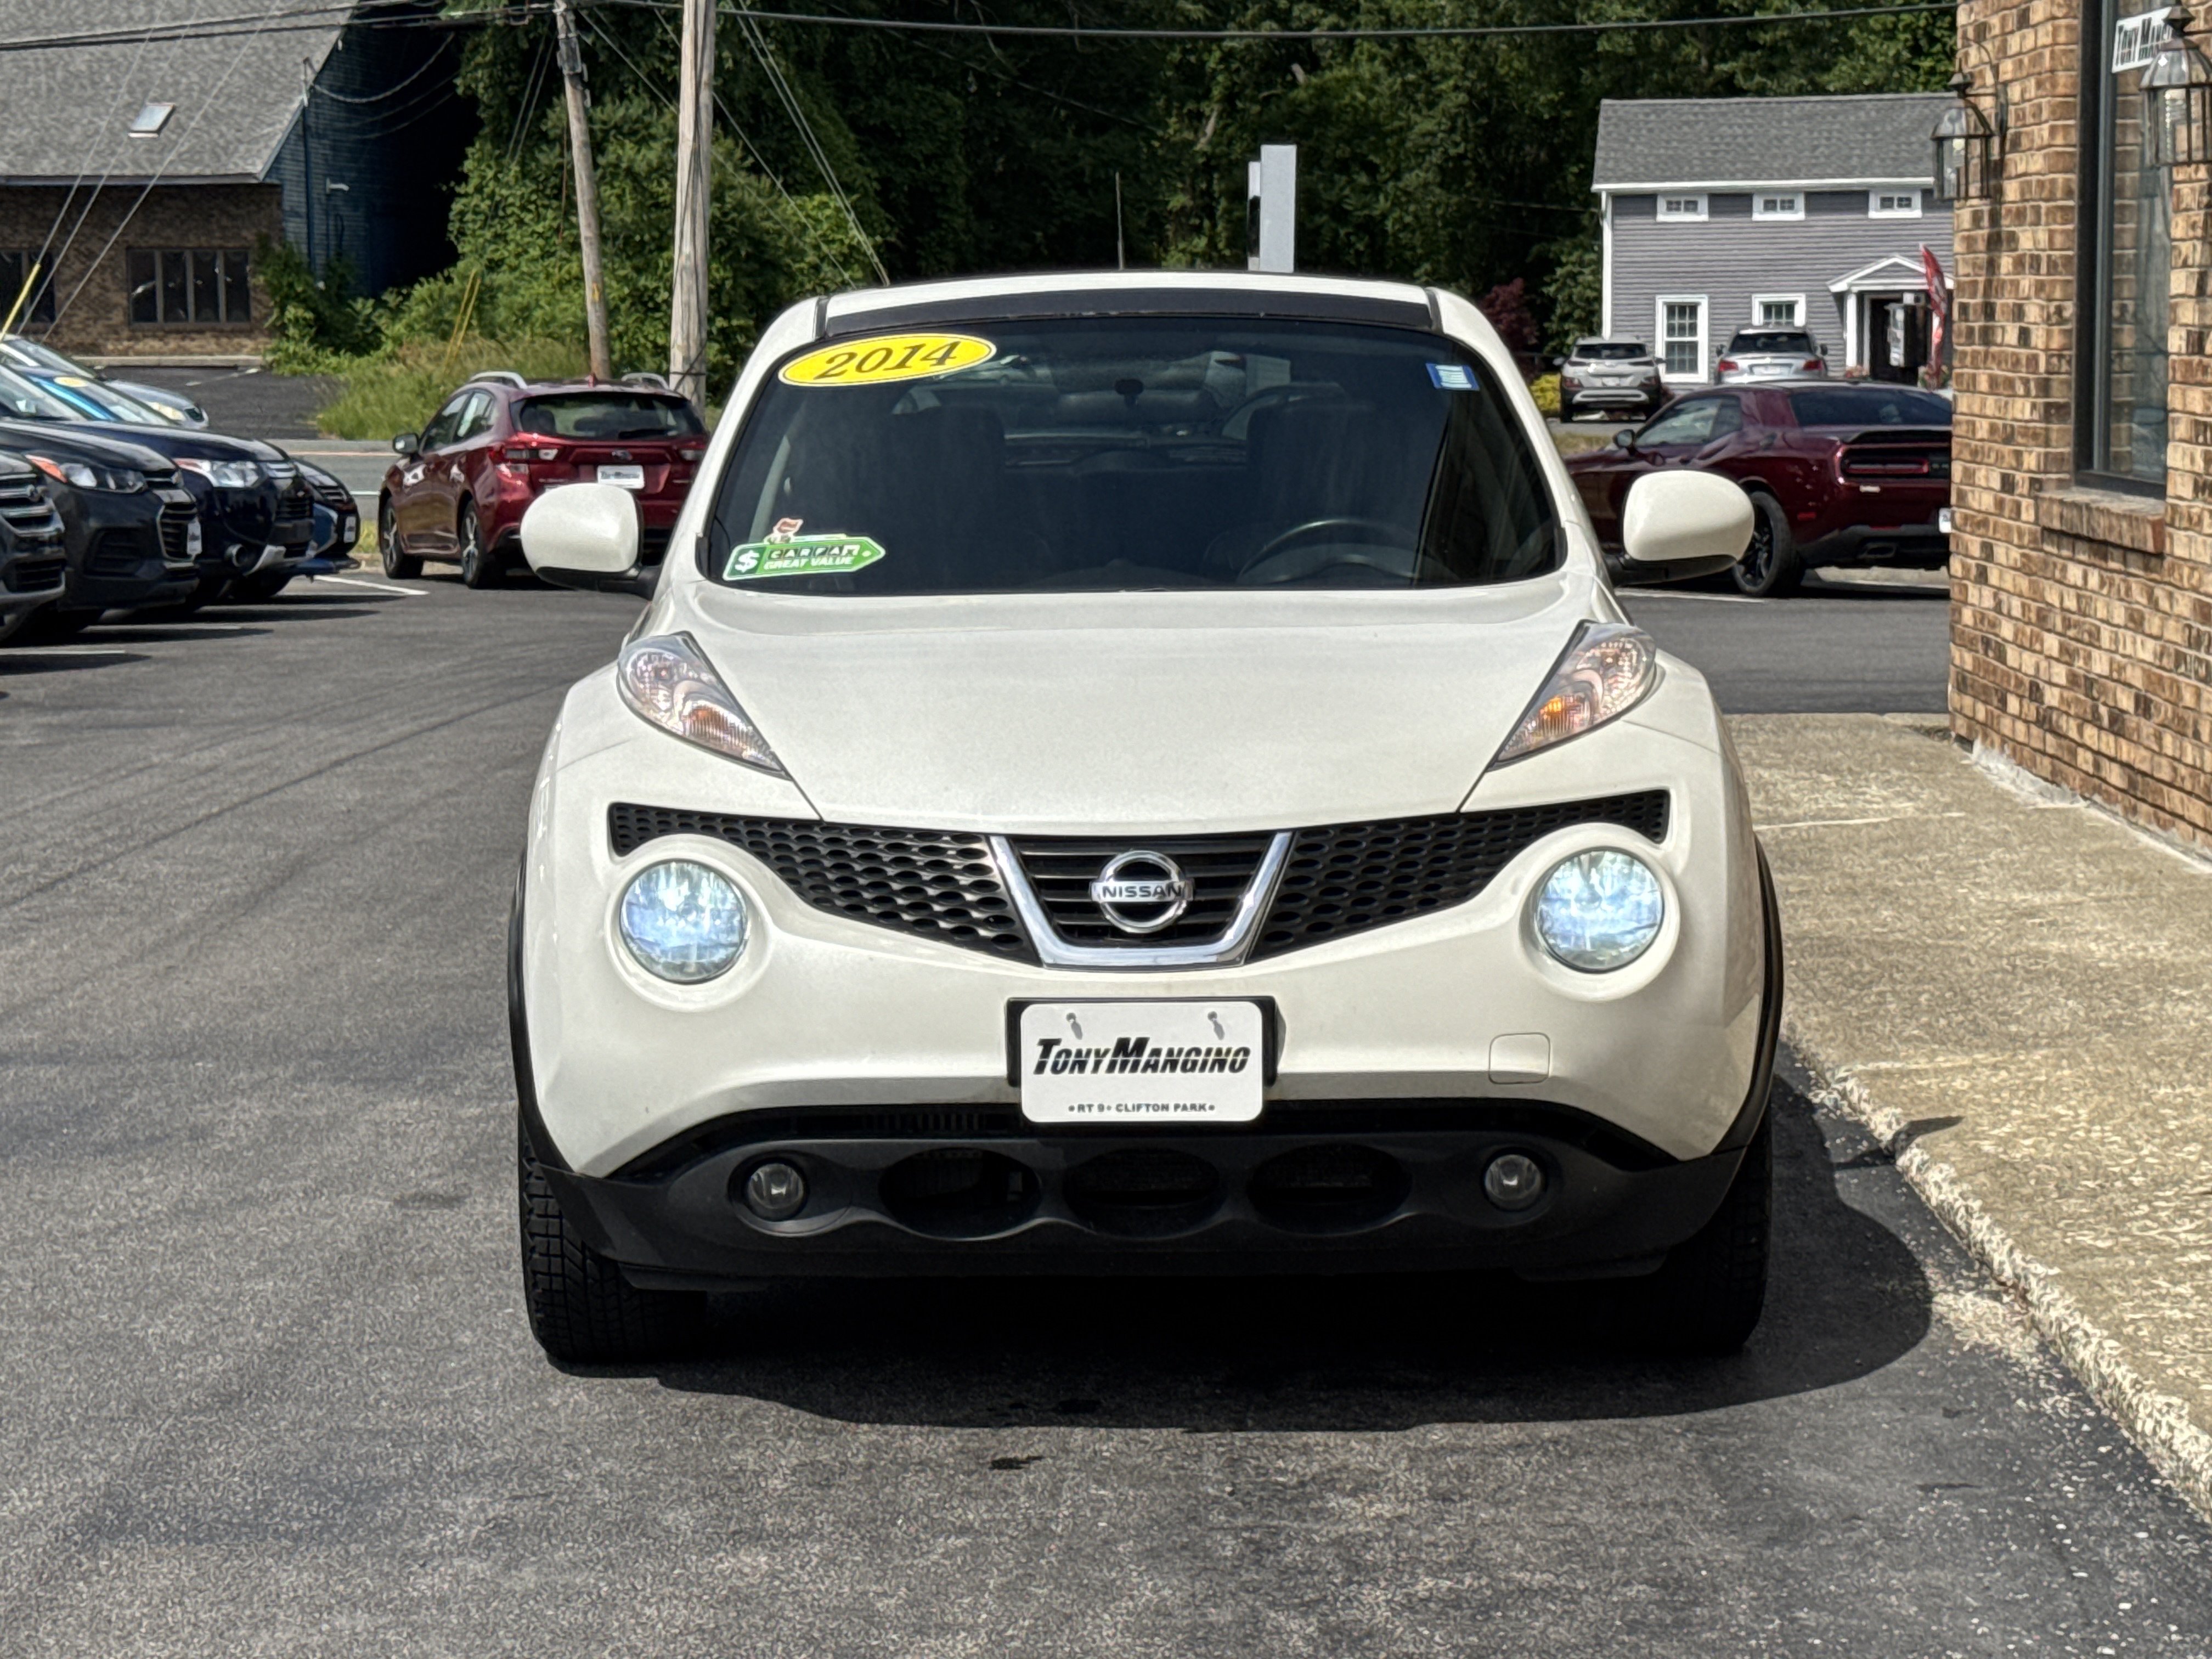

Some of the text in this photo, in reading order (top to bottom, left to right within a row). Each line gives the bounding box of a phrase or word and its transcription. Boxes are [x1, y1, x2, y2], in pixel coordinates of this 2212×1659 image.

[814, 341, 961, 380] 2014
[763, 555, 854, 569] GREAT VALUE
[1102, 882, 1182, 898] NISSAN
[1077, 1103, 1094, 1113] RT
[1115, 1103, 1170, 1113] CLIFTON
[1173, 1103, 1207, 1113] PARK
